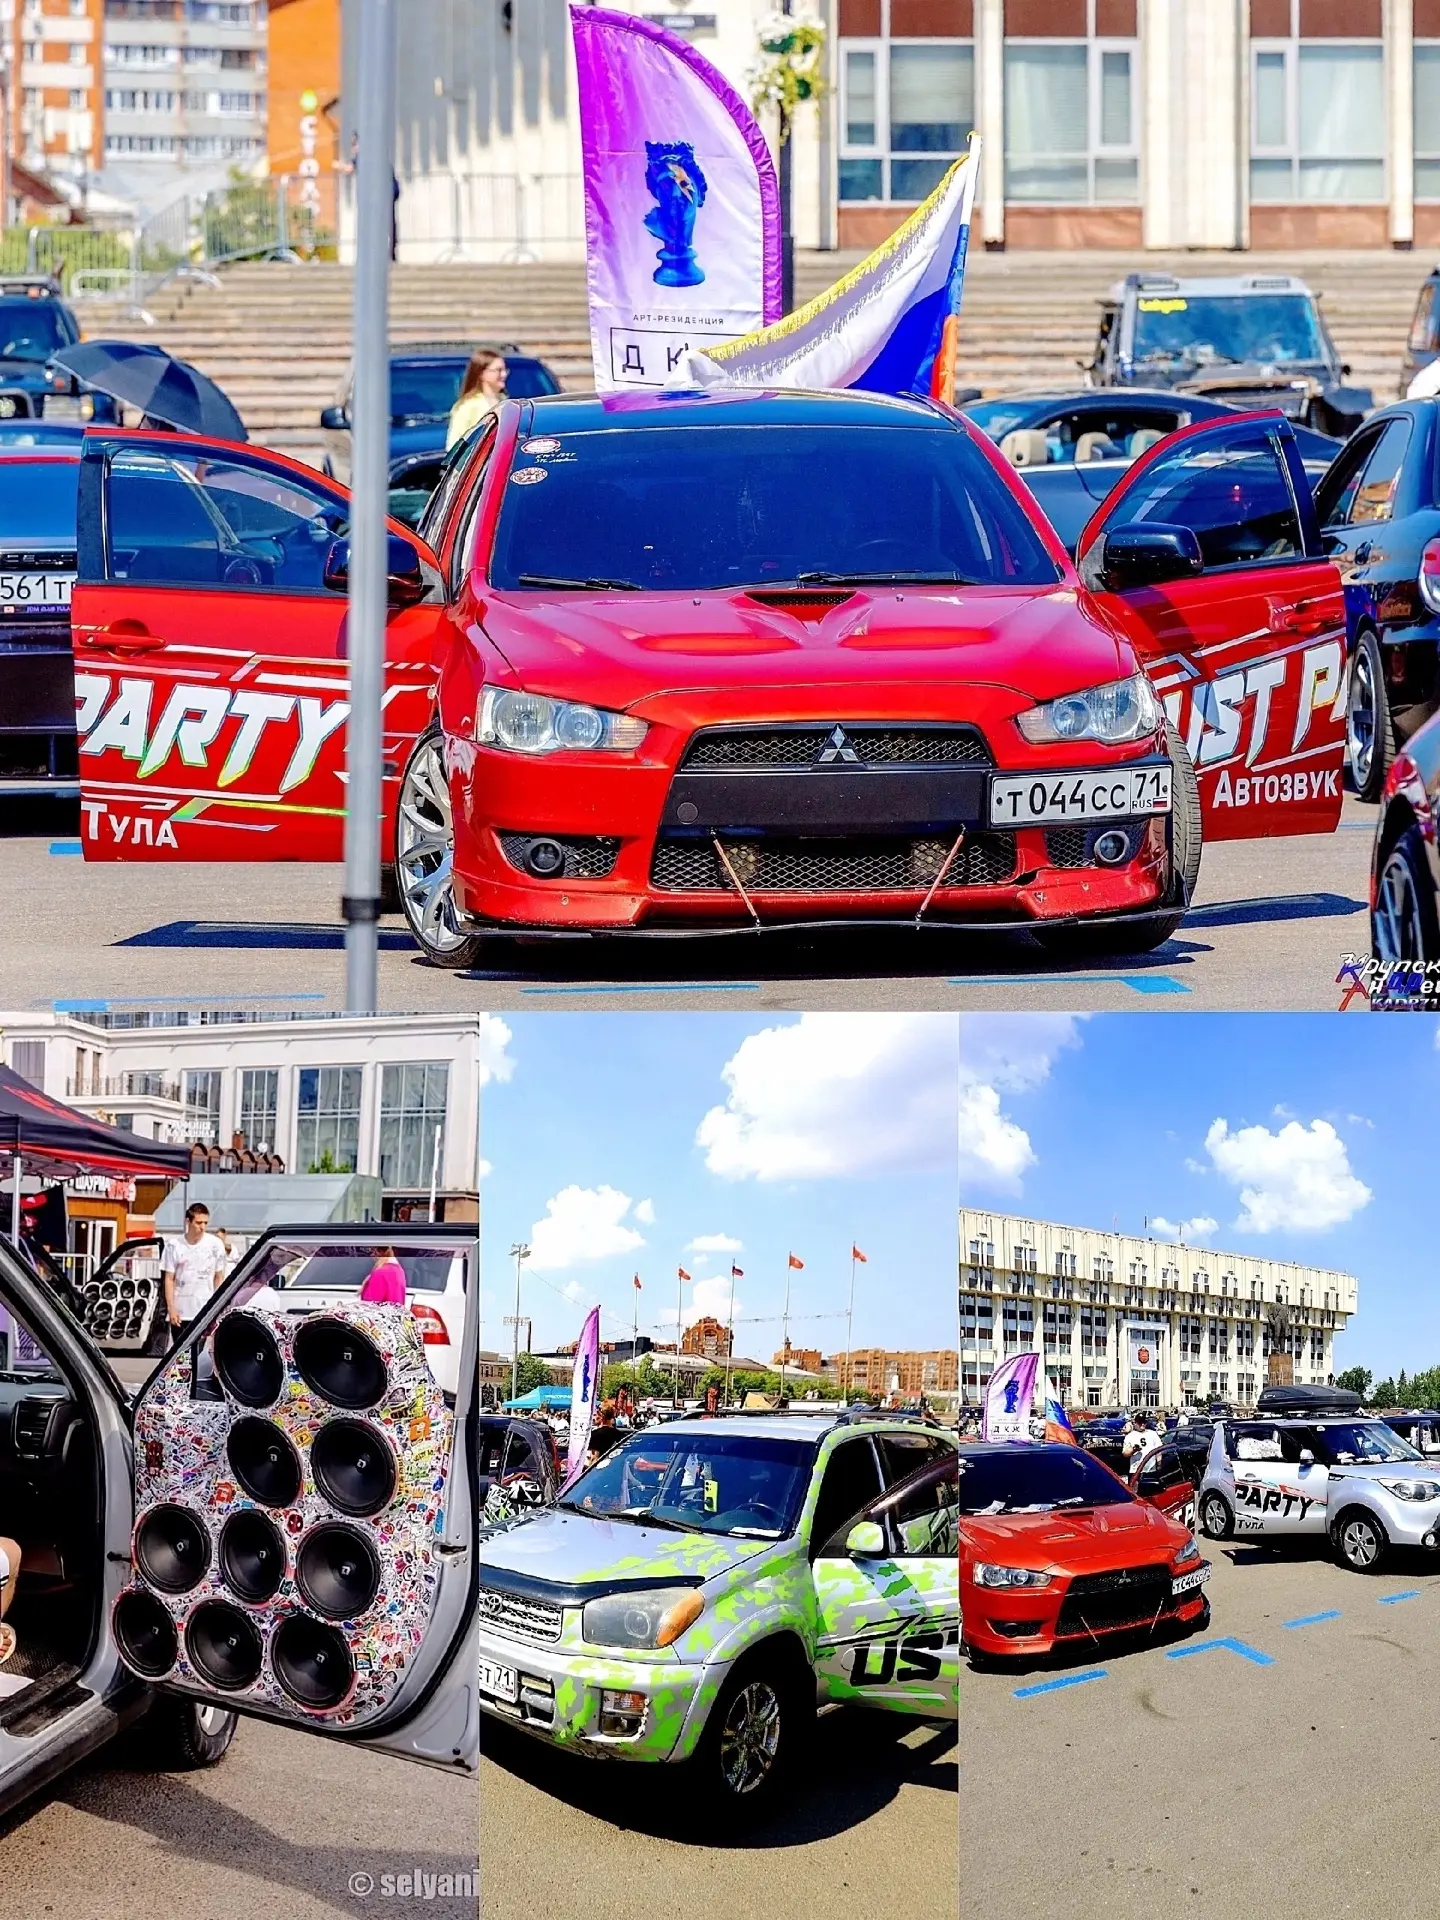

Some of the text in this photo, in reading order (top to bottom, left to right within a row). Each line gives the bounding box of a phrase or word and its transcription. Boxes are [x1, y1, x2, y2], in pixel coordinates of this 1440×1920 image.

[633, 314, 724, 325] АРТ-РЕЗИДЕНЦИЯ
[1134, 771, 1161, 799] 71
[1131, 799, 1152, 810] RUS
[496, 1666, 510, 1686] 71
